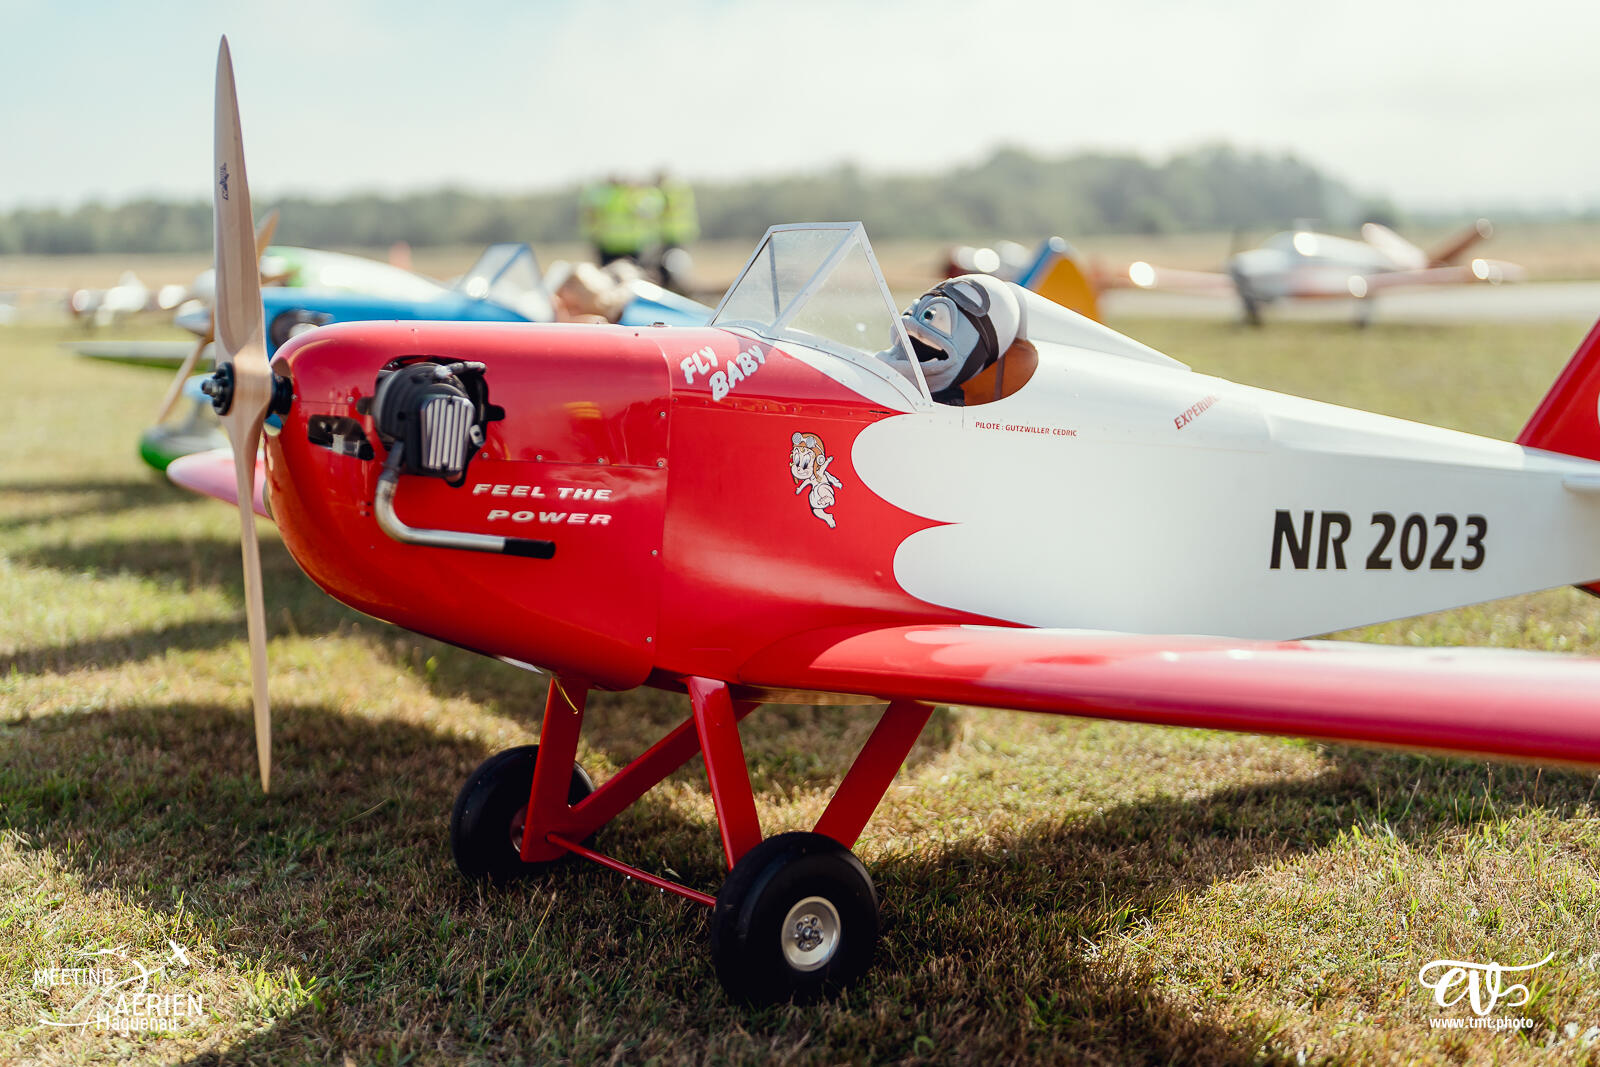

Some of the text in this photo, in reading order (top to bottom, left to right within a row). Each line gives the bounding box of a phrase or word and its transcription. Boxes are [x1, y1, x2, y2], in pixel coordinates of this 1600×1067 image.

[680, 346, 718, 385] FLY
[709, 345, 766, 402] BABY
[975, 421, 1000, 430] PILOTE
[1005, 424, 1050, 434] GUTZWILLER
[1052, 428, 1077, 437] CEDRIC
[472, 483, 613, 501] FEEL THE
[487, 509, 612, 525] POWER
[1270, 509, 1488, 571] NR 2023
